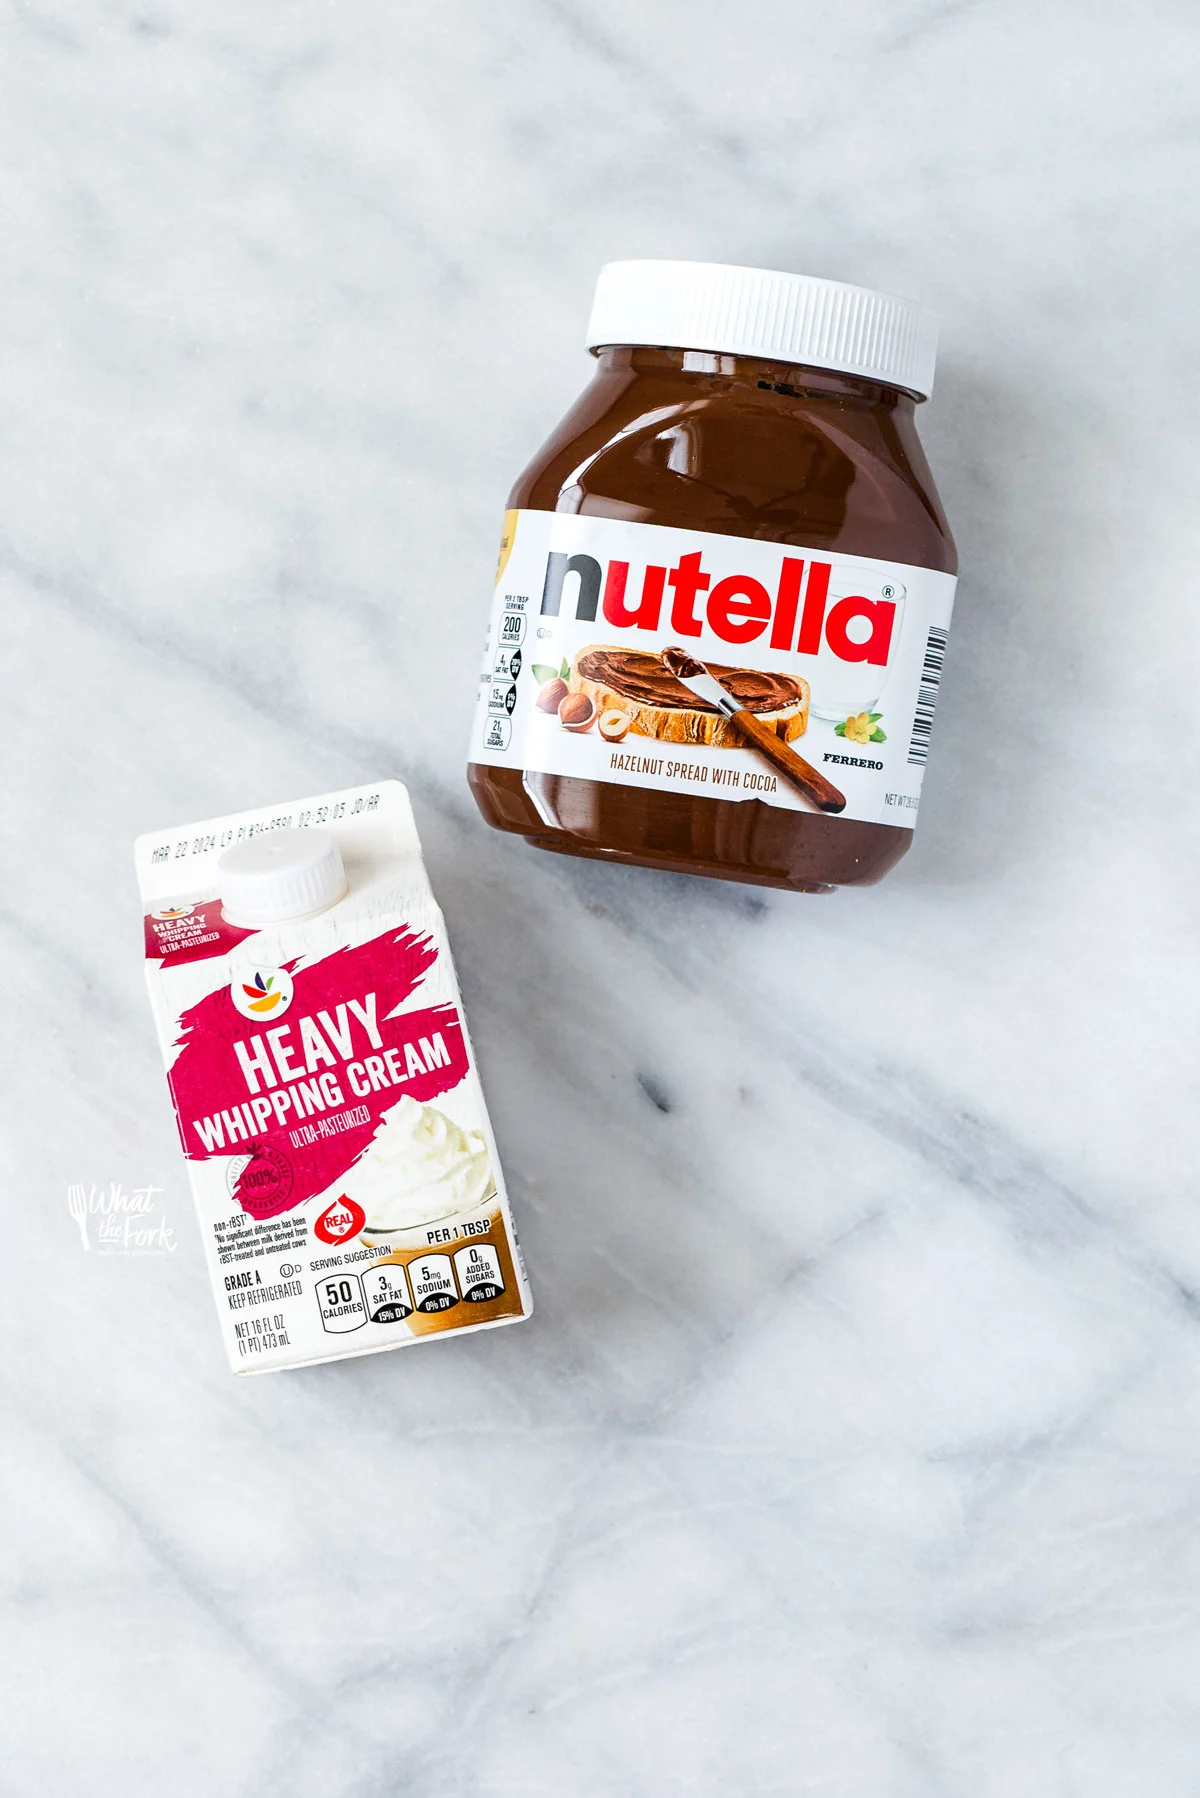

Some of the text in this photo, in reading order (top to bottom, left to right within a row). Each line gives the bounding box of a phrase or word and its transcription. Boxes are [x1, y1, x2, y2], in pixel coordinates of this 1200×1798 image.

[539, 551, 897, 667] nutella
[503, 616, 521, 633] 200
[502, 633, 520, 642] CALORIES
[822, 753, 883, 771] FERRERO
[610, 753, 777, 793] HAZELNUT SPREAD WITH COCOA
[884, 793, 898, 806] NET
[151, 845, 171, 864] MAR
[175, 841, 189, 859] 22
[192, 835, 216, 854] 2024
[152, 914, 207, 932] HEAVY
[157, 923, 207, 938] WHIPPING
[159, 931, 220, 954] ULTRA-PASTEURIZED
[168, 930, 203, 942] CREAM
[233, 992, 384, 1095] HEAVY
[193, 1031, 452, 1153] WHIPPING CREAM
[288, 1104, 372, 1149] ULTRA-PASTEURIZED
[242, 1168, 278, 1189] 100%
[226, 1228, 254, 1243] significant
[254, 1223, 281, 1235] difference
[281, 1219, 292, 1228] has
[292, 1217, 306, 1226] been
[325, 1213, 354, 1229] REAL
[427, 1219, 491, 1244] PER 1 TBSP
[217, 1228, 308, 1254] shown between milk derived from
[220, 1239, 307, 1265] rBST-treated and untreated cows
[310, 1245, 391, 1271] SERVING SUGGESTION
[465, 1270, 495, 1284] SUGARS
[466, 1262, 491, 1275] ADDED
[224, 1270, 262, 1291] GRADE A
[417, 1279, 452, 1295] SODIUM
[228, 1280, 302, 1310] KEEP REFRIGERATED
[326, 1281, 352, 1306] 50
[373, 1289, 403, 1304] SAT FAT
[425, 1296, 450, 1311] 0% DV
[471, 1287, 496, 1301] 0% DV
[323, 1302, 363, 1319] CALORIES
[378, 1307, 406, 1322] 15% DV
[235, 1314, 285, 1339] NET 16 FL OZ
[238, 1330, 291, 1357] (1 PT) 473 mL
